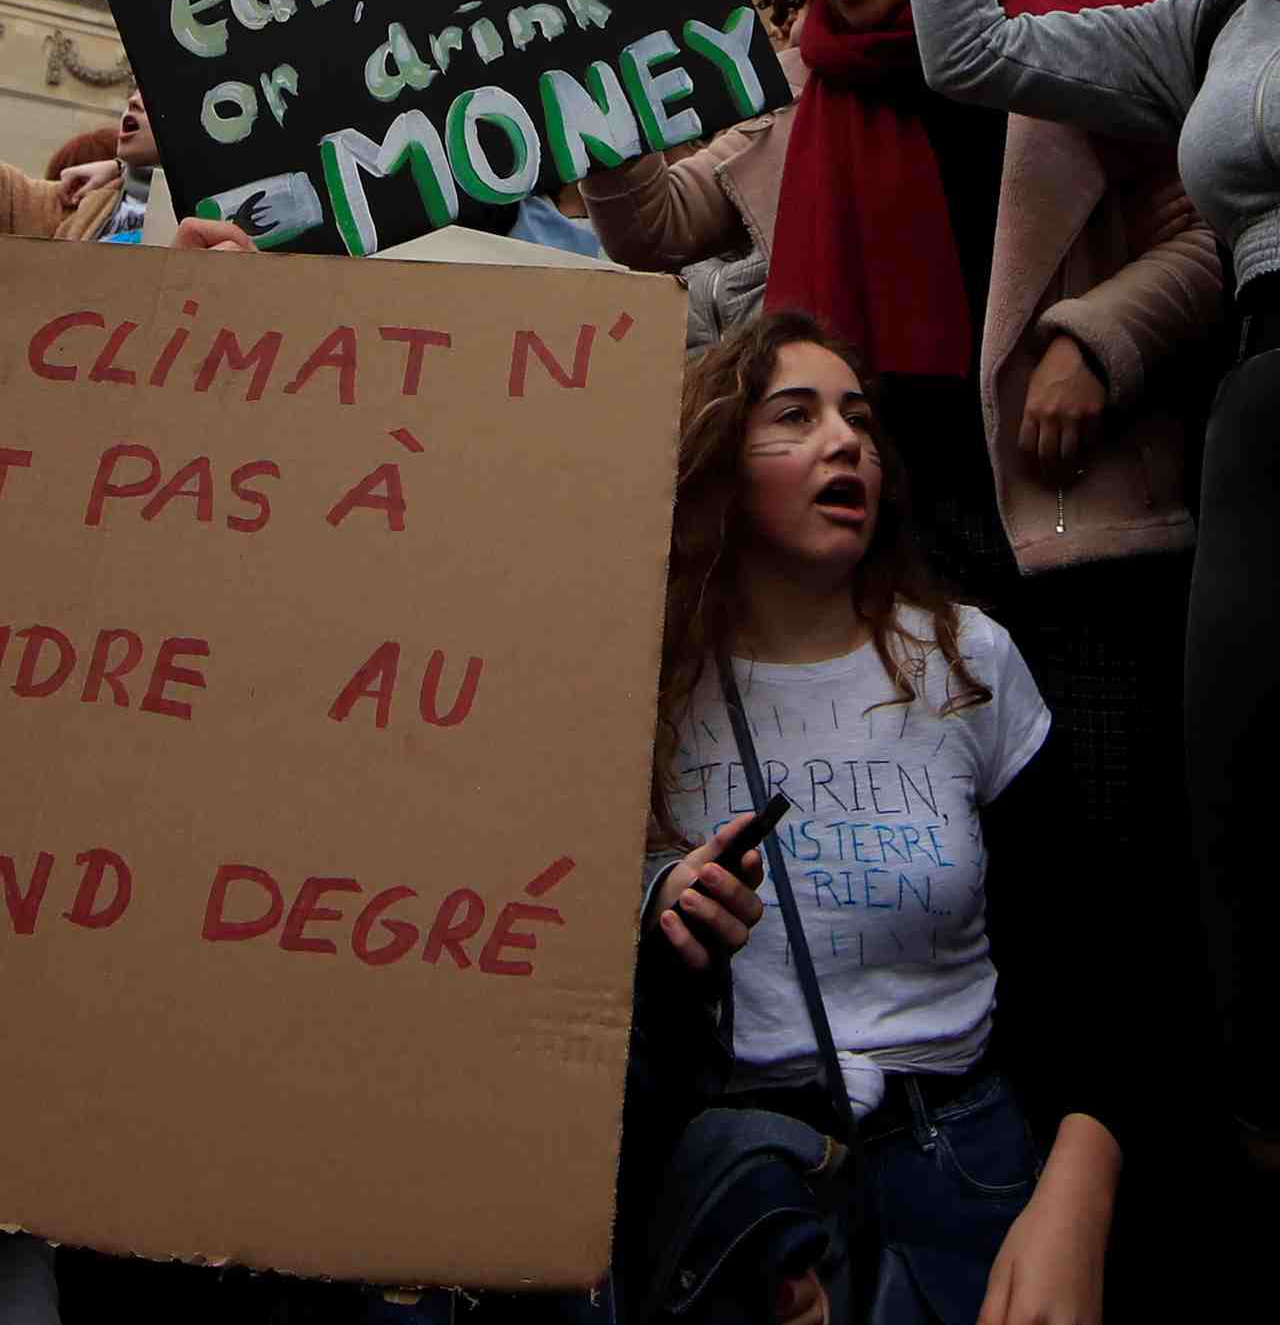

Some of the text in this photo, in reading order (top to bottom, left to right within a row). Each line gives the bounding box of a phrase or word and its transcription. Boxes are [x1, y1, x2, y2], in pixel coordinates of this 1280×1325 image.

[200, 62, 300, 145] or
[321, 6, 766, 258] MONEY
[506, 311, 635, 399] N'
[84, 442, 282, 533] PAS
[324, 427, 425, 533] À
[327, 640, 484, 730] AU
[825, 822, 956, 868] TERRE
[200, 854, 578, 978] DEGRÉ
